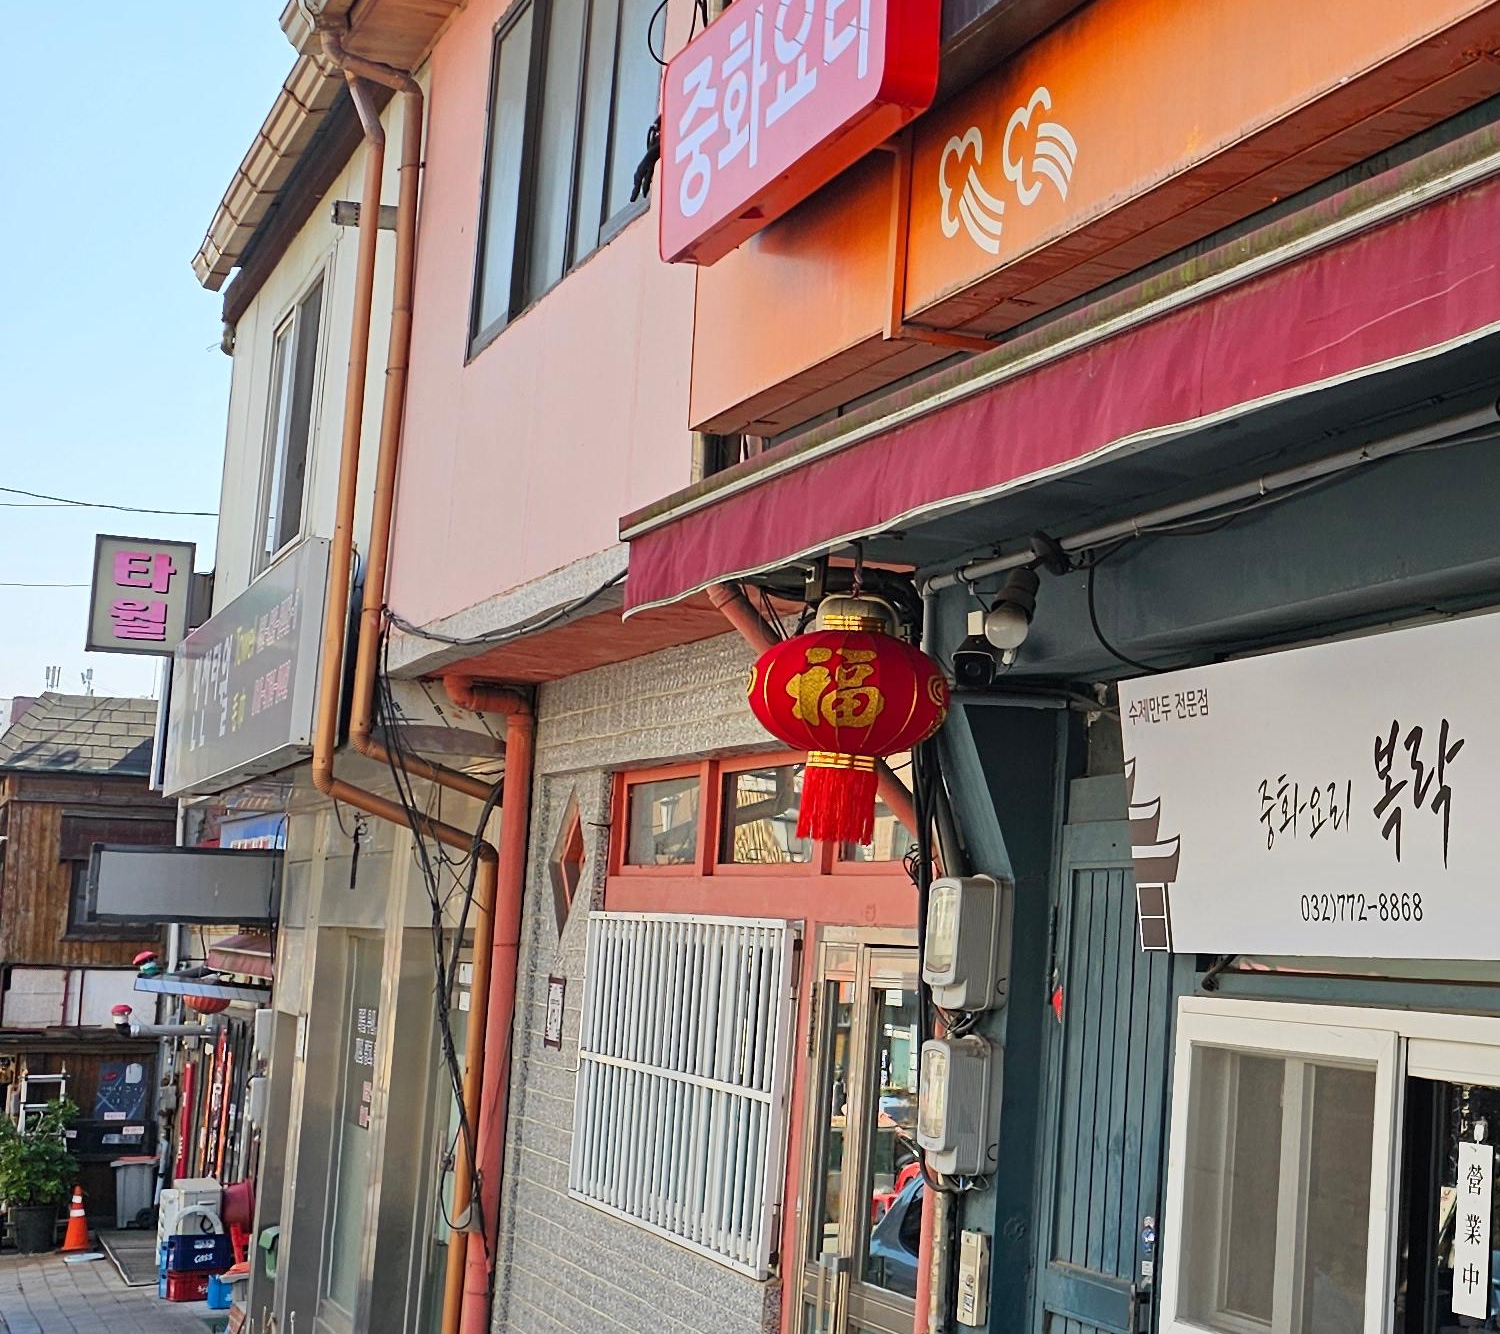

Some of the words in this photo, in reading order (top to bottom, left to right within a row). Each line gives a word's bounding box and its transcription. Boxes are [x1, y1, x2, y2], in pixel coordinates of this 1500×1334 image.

[106, 550, 177, 641] 타월
[785, 647, 885, 728] 福
[1128, 694, 1171, 725] 수제만두
[1174, 688, 1210, 720] 전문점
[1257, 774, 1352, 851] 중화요리
[1373, 718, 1465, 870] 복락
[1300, 891, 1424, 923] 032)772-8868
